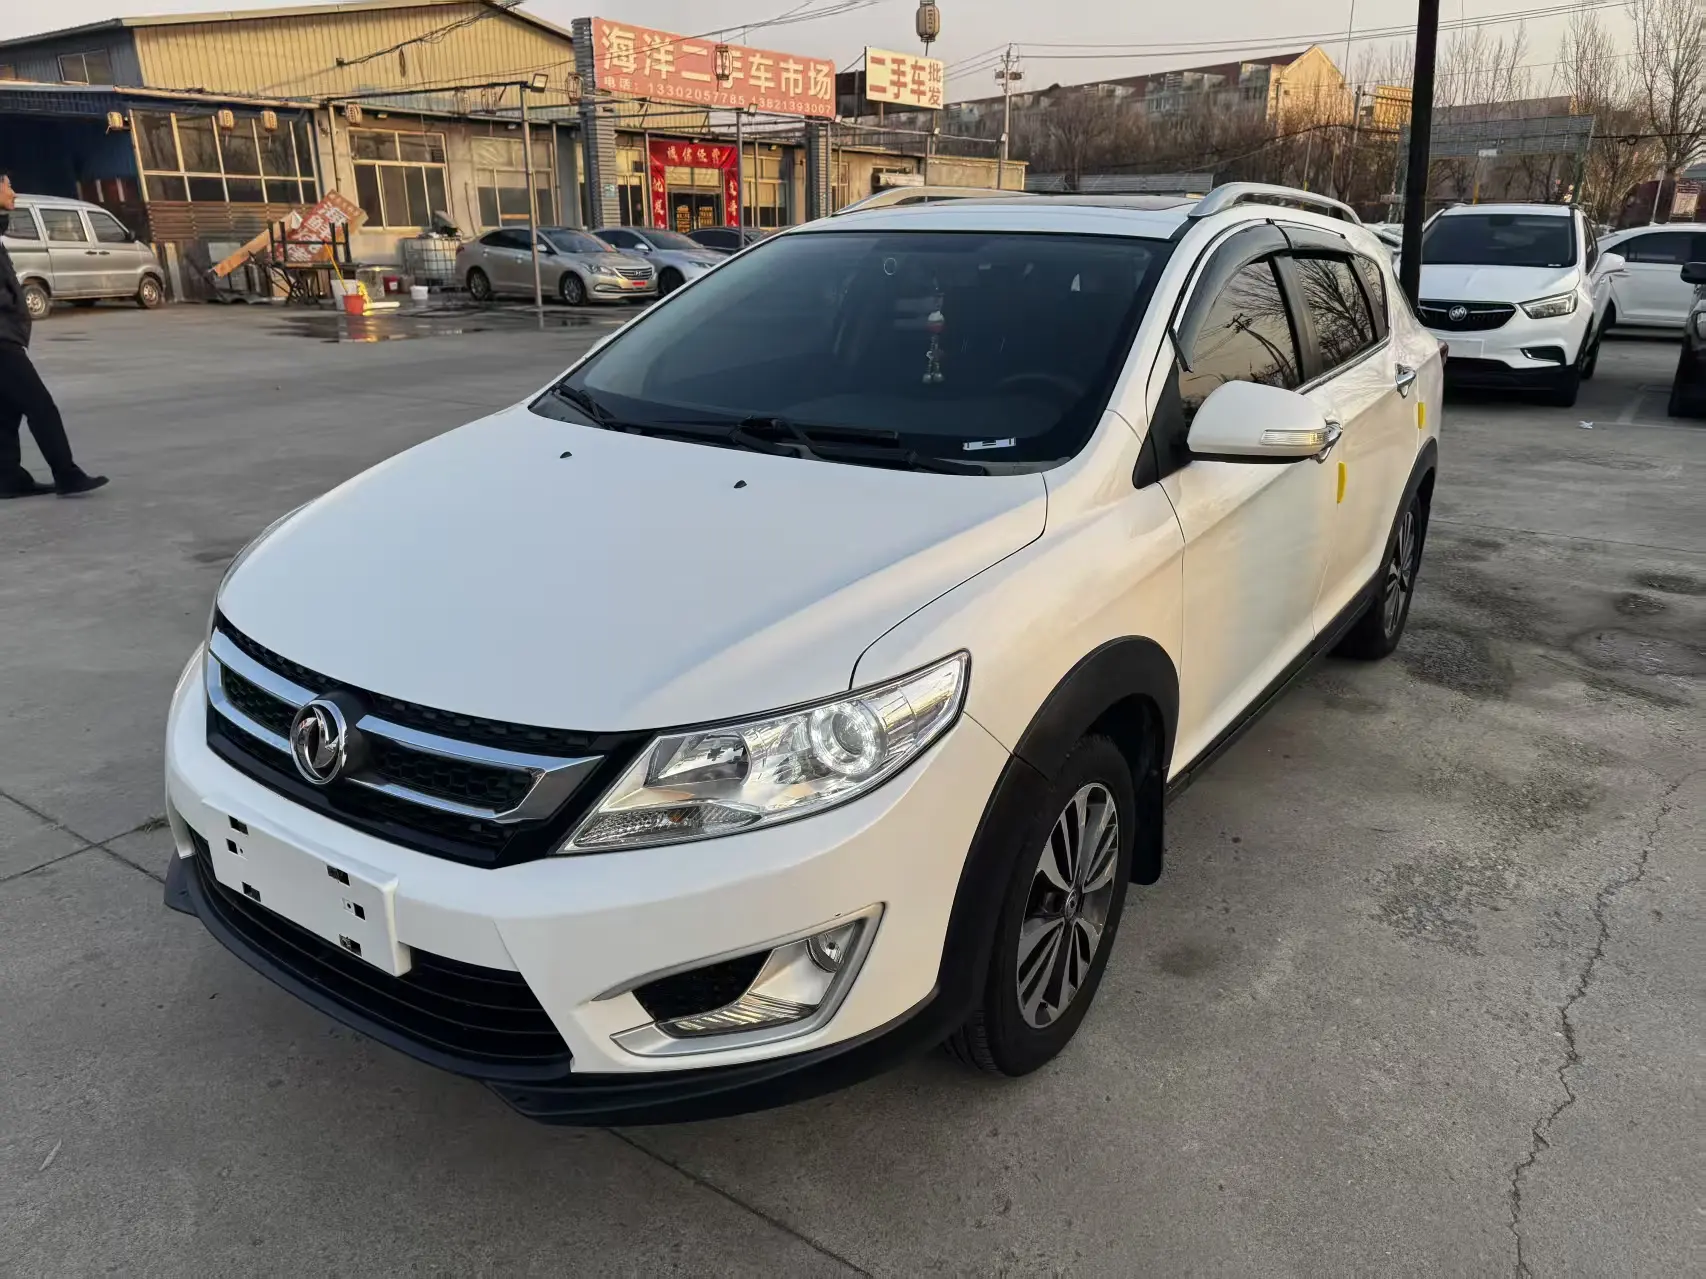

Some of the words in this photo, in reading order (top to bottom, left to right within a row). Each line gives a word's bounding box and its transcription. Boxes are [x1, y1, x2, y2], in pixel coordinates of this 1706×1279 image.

[601, 24, 833, 100] 海洋二手车市场
[869, 55, 927, 104] 二手车
[928, 61, 942, 107] 批发
[647, 82, 746, 105] 13302057785
